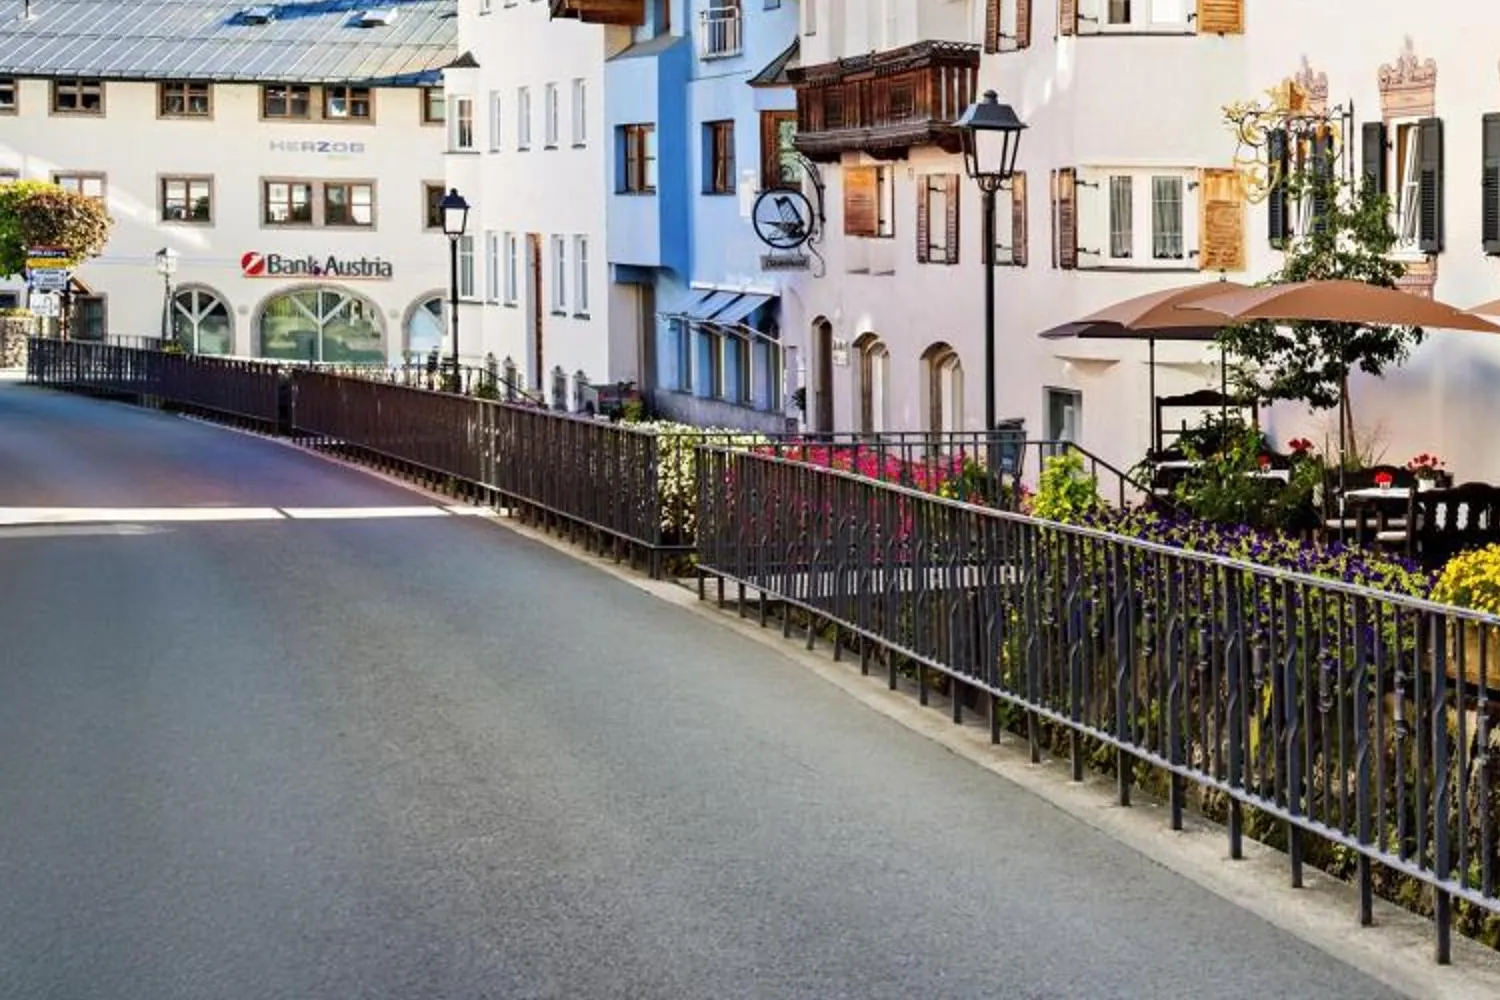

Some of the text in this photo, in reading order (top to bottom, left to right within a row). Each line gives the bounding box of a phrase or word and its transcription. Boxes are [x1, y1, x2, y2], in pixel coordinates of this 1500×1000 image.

[269, 140, 366, 153] HERZOG
[267, 253, 393, 277] Bank Austria
